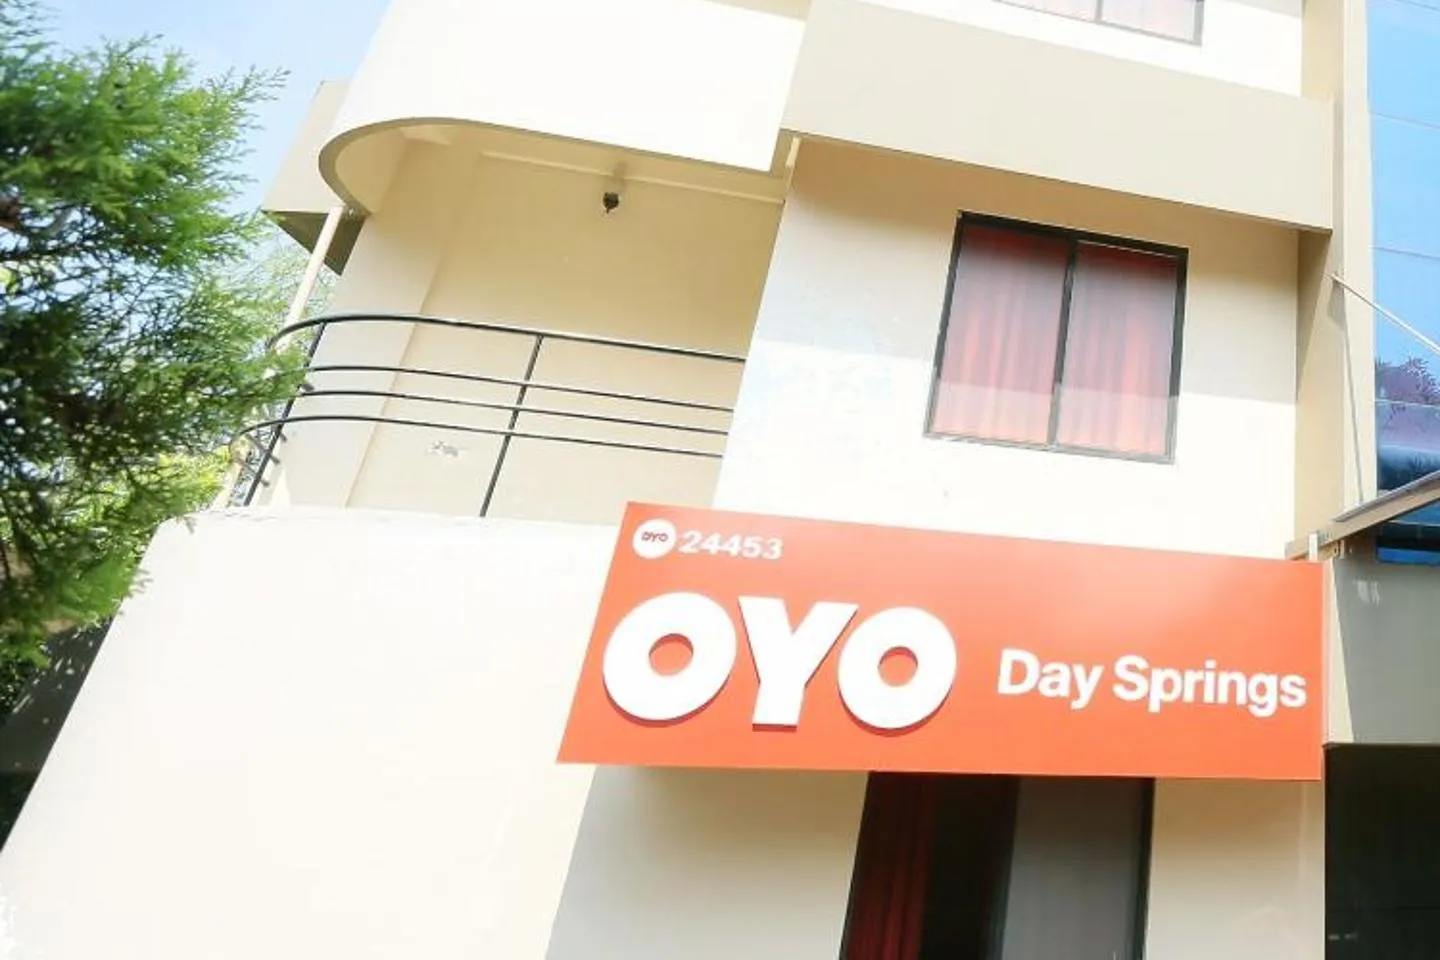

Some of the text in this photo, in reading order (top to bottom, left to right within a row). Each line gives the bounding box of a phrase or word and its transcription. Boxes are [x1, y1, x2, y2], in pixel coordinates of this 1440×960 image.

[641, 529, 783, 560] OYO 24453
[602, 591, 957, 736] OYO
[997, 648, 1307, 718] Day Springs
